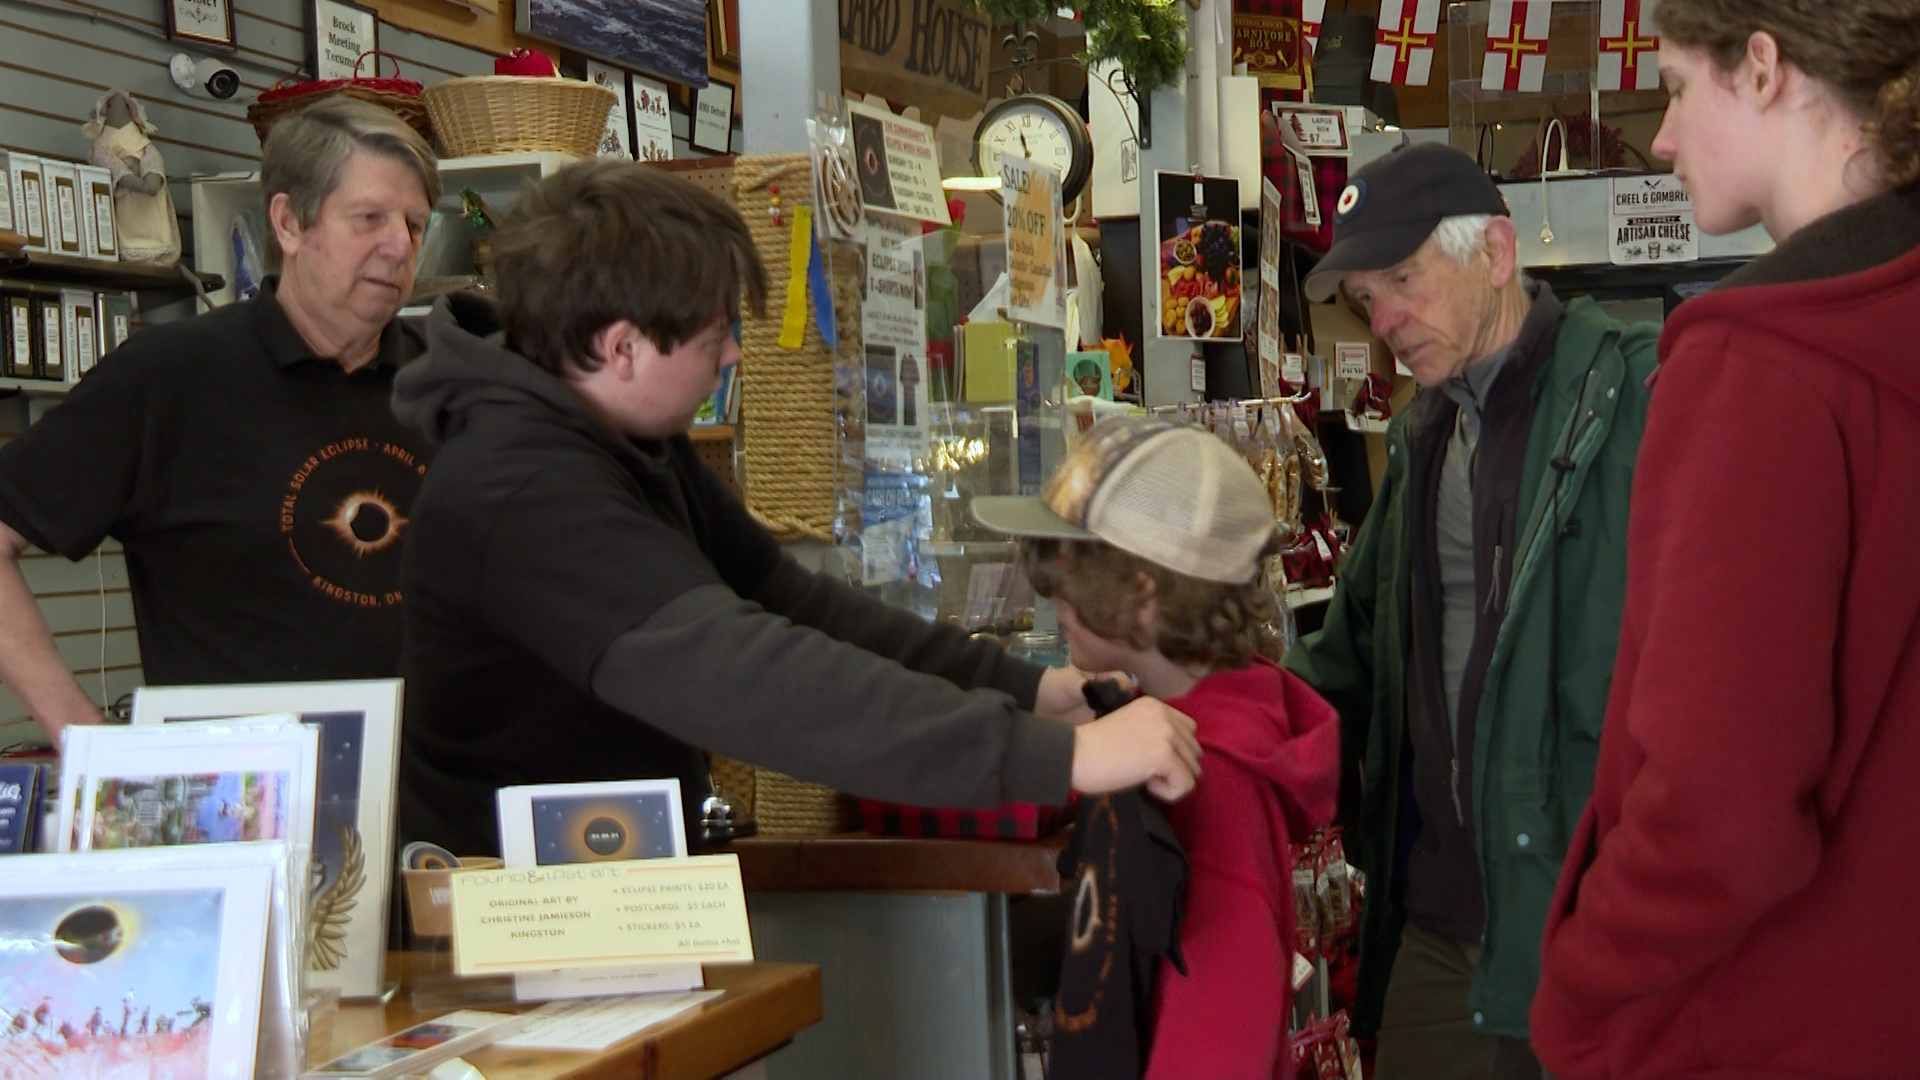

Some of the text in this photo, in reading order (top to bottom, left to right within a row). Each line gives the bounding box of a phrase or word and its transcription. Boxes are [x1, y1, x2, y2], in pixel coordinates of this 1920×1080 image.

[333, 15, 356, 34] Brock
[1235, 29, 1291, 43] ARNIVORE
[328, 32, 362, 56] Meeting
[841, 0, 988, 96] ARD HOUSE
[1249, 37, 1271, 50] BOX
[325, 48, 366, 72] Tecumsh
[1312, 117, 1333, 125] LARGE
[1003, 163, 1030, 195] SALE!
[1616, 193, 1640, 206] CREEL
[1006, 205, 1046, 236] 20% OFF
[1616, 223, 1691, 245] ARTISAN CHEESE
[282, 493, 298, 533] TOTAL
[290, 456, 320, 490] SOLAR
[320, 437, 370, 461] ECLIPSE
[384, 443, 416, 467] APRIL
[621, 886, 658, 894] ECLIPSE
[717, 881, 731, 890] EA
[489, 895, 580, 908] ORIGINAL ART BY
[701, 900, 726, 909] EACH
[480, 910, 592, 925] CHRISTINE JAMIESON
[689, 920, 702, 929] EA
[510, 927, 567, 938] KINGSTON
